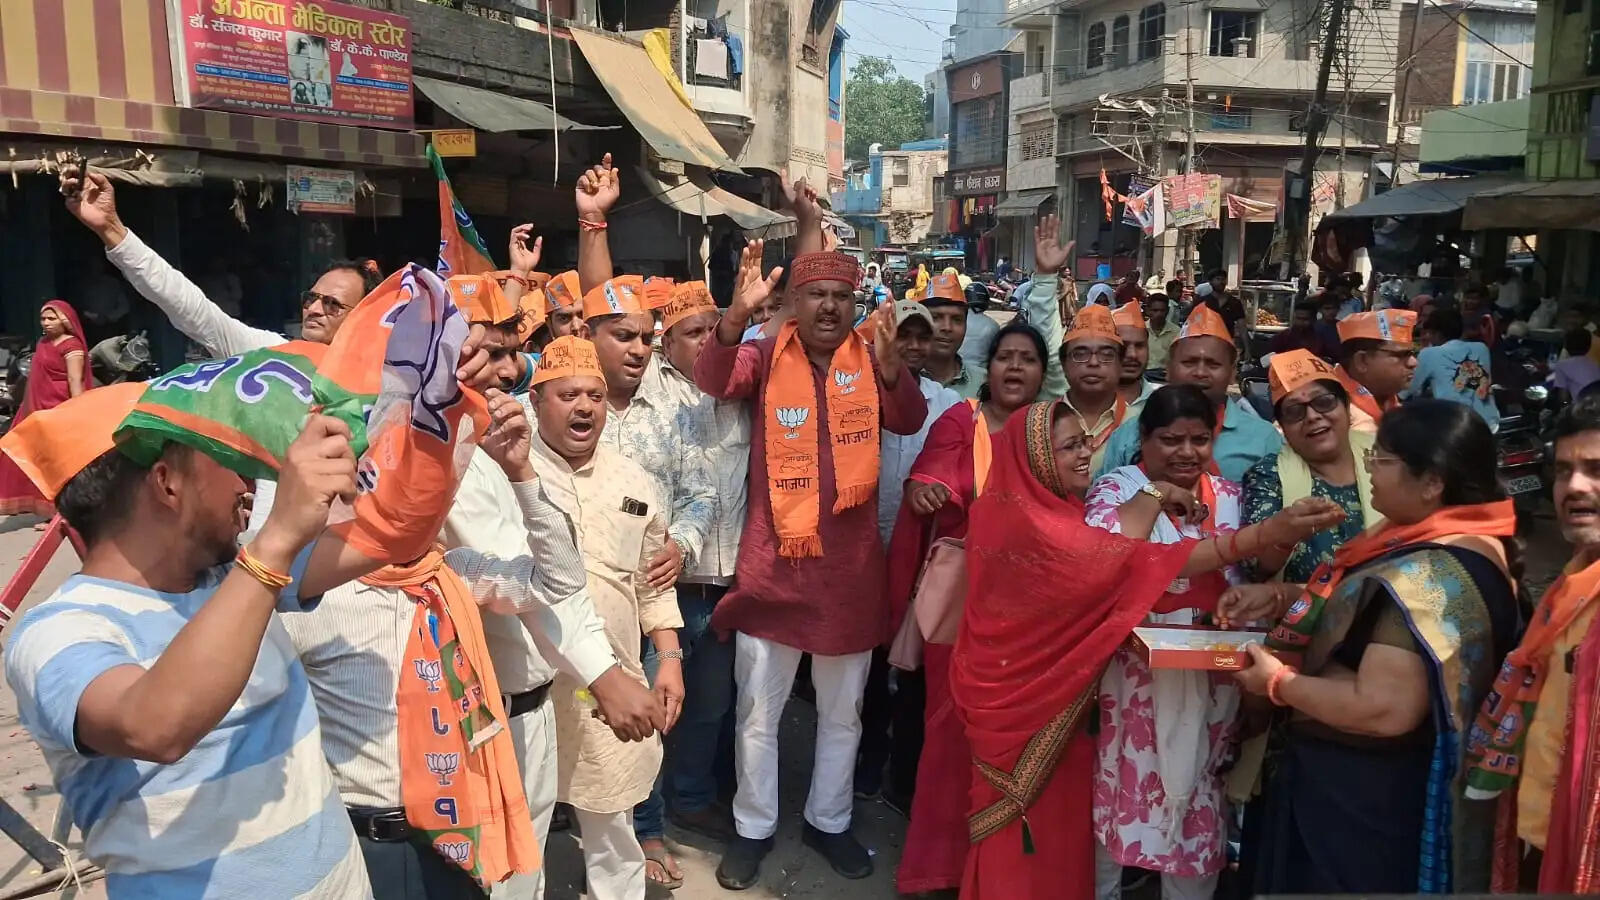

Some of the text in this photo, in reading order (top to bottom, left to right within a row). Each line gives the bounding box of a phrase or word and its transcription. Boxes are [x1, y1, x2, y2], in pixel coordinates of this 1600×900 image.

[188, 14, 283, 42] डॉ. संजय कुमार
[211, 0, 407, 48] अजन्ता मेडिकल स्टोर
[329, 38, 345, 53] डॉ.
[379, 47, 409, 63] पाण्डेय
[836, 427, 873, 446] भाजपा
[775, 477, 813, 491] भाजपा
